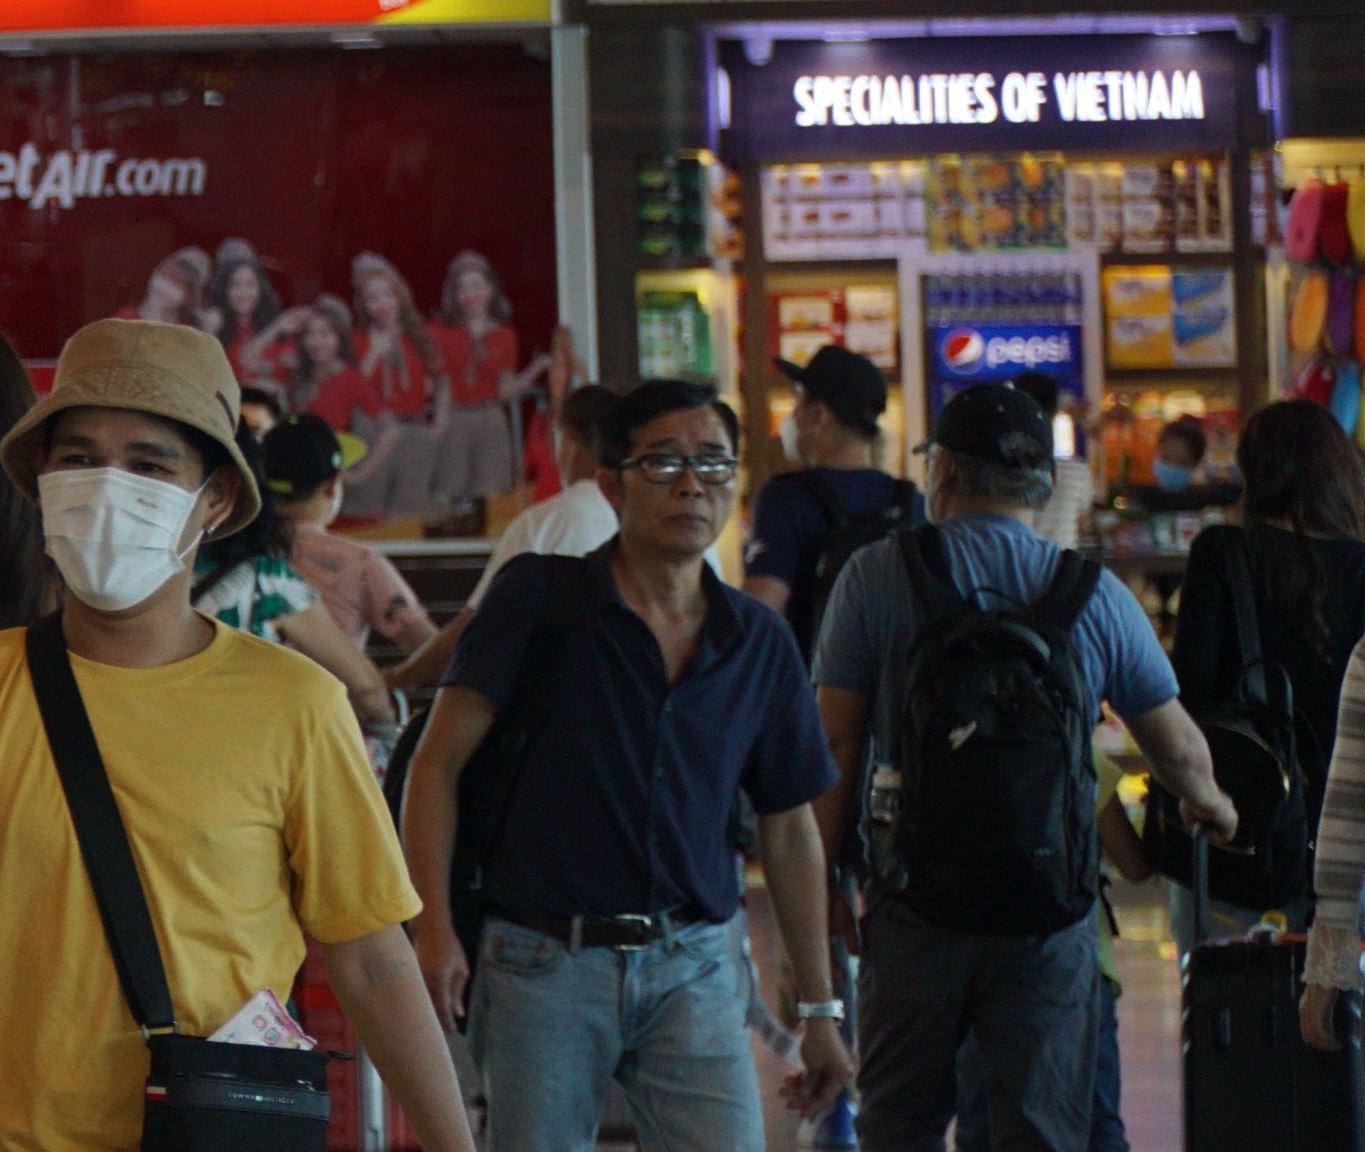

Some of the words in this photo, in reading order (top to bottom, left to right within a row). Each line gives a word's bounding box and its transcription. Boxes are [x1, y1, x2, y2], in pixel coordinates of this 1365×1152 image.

[793, 75, 998, 127] SPECIALITIES
[1001, 73, 1047, 123] OF
[1054, 70, 1205, 121] VIETNAM
[986, 330, 1071, 370] pepsi
